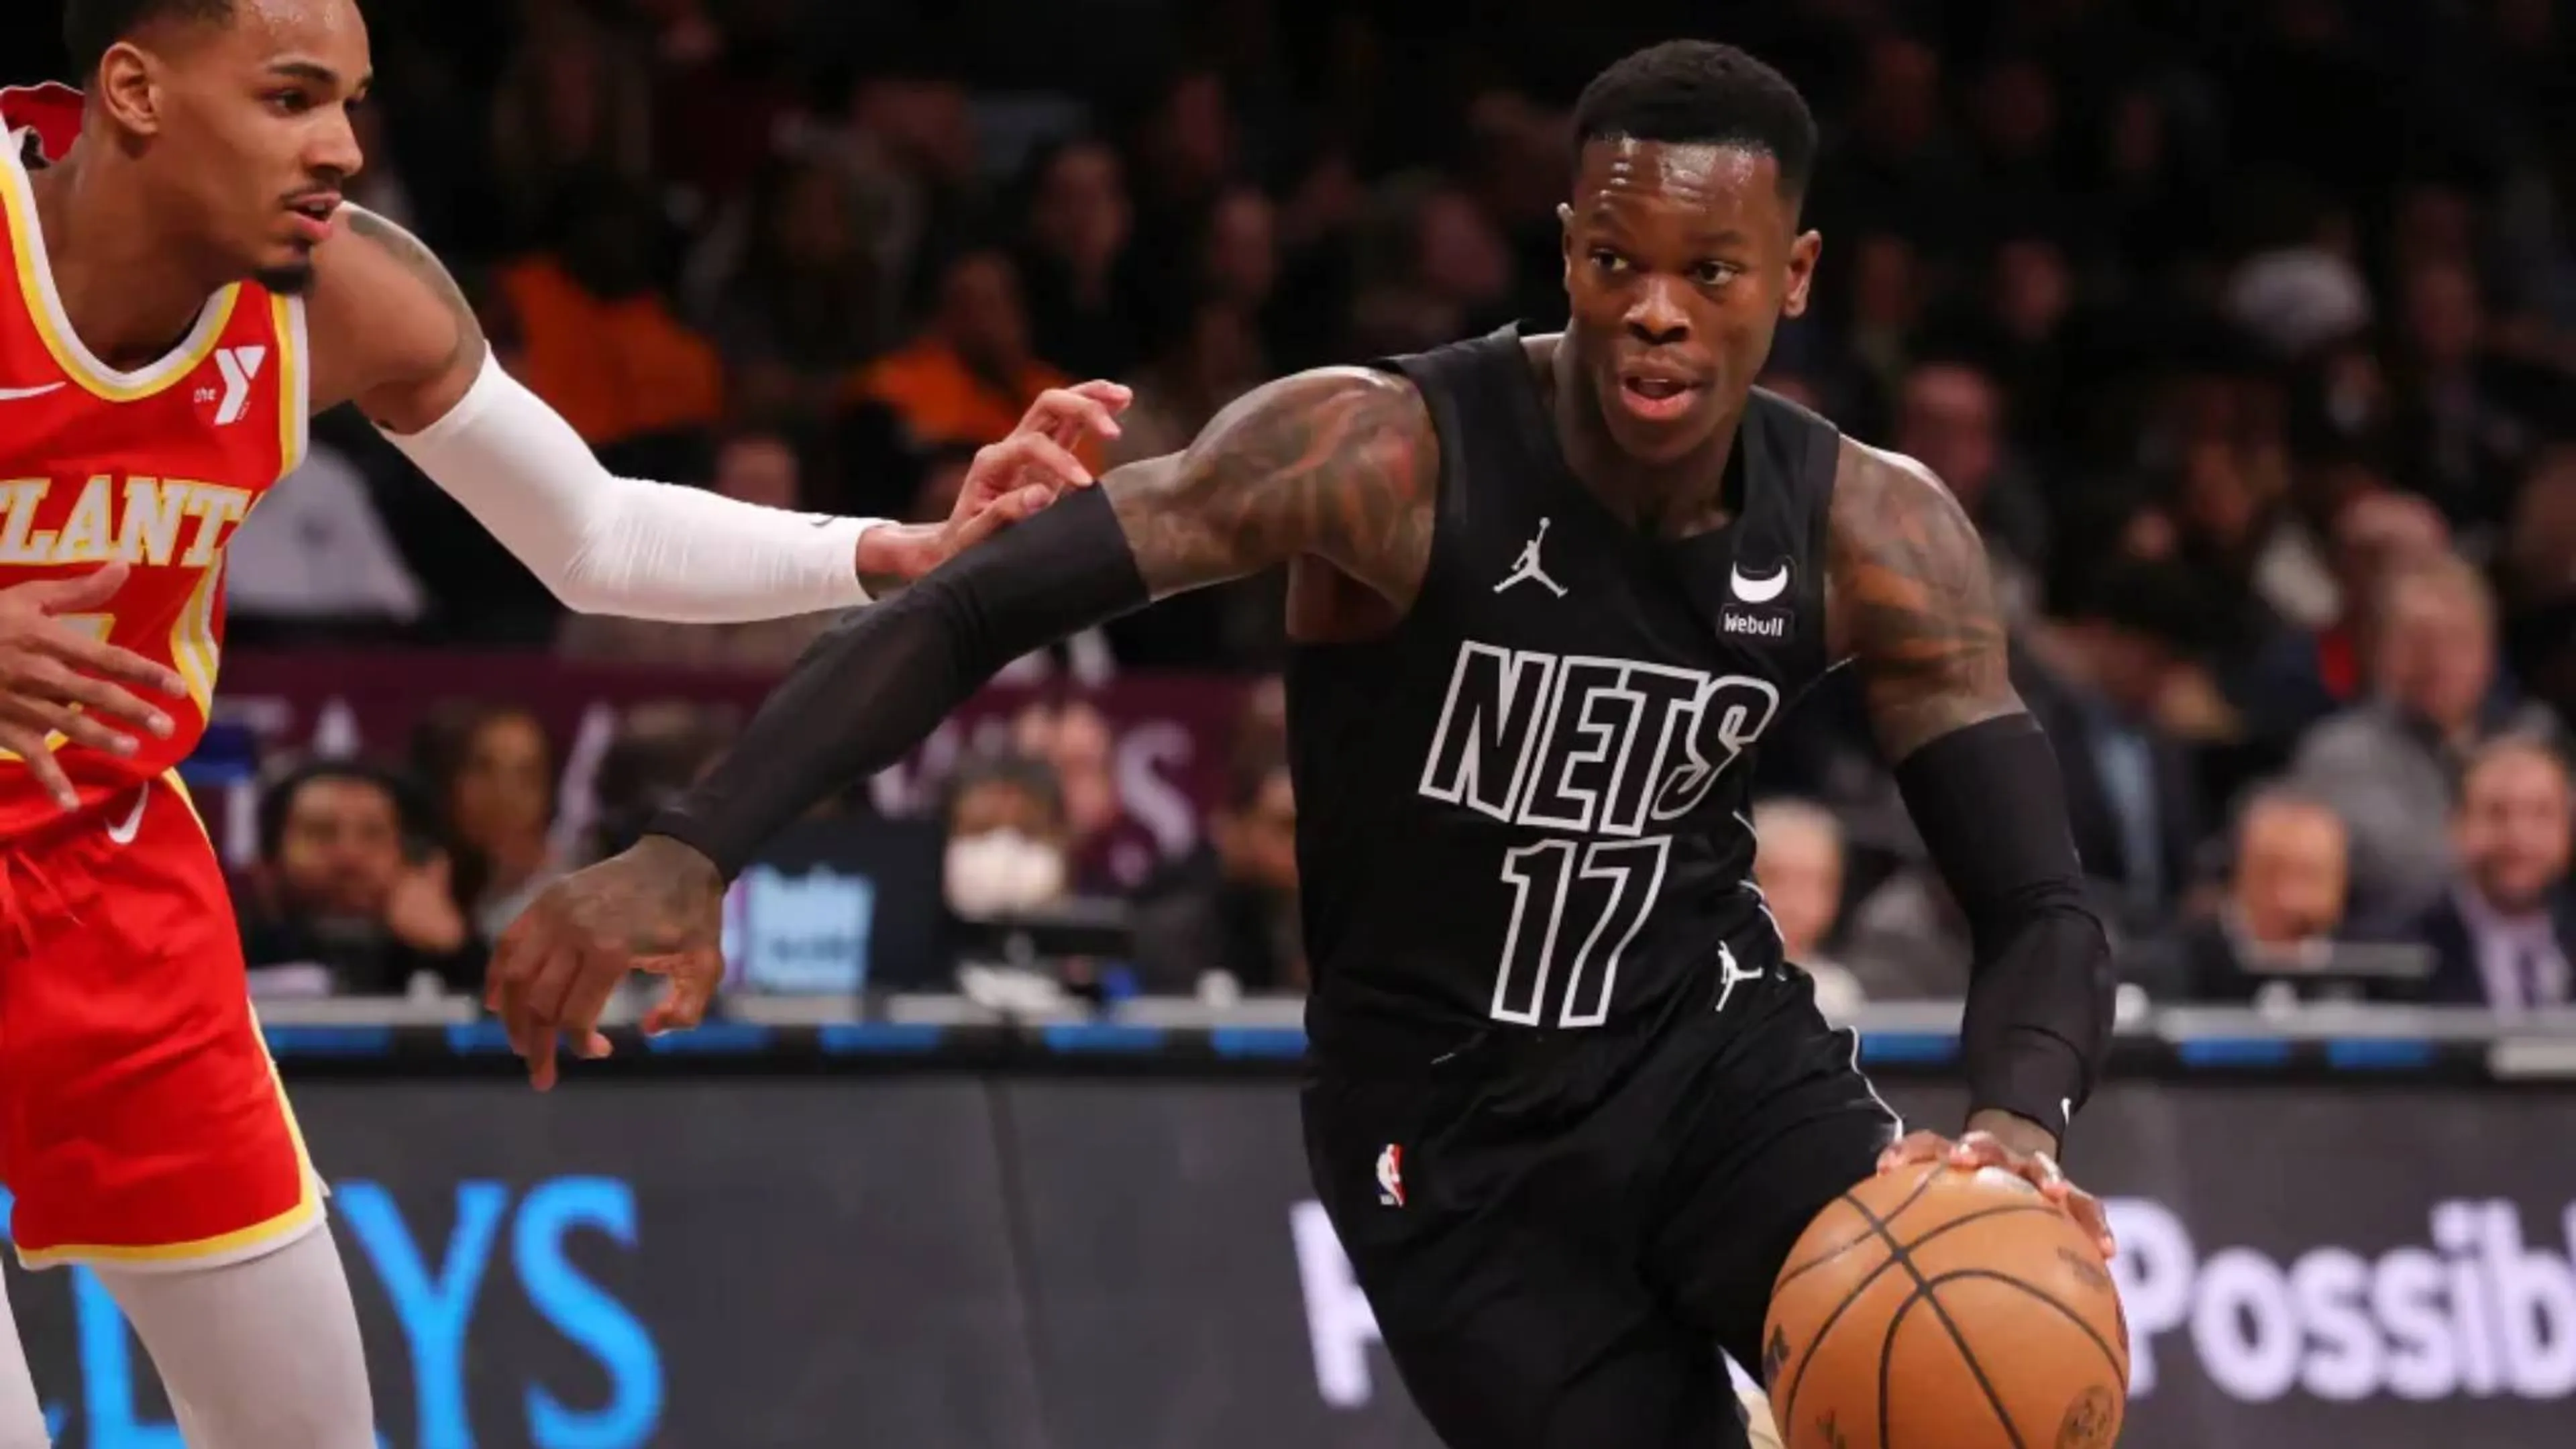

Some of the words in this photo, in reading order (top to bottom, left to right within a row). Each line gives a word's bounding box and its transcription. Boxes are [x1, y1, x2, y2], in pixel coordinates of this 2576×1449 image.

[0, 474, 253, 567] LANT
[1724, 612, 1784, 637] Webull
[1418, 640, 1780, 837] NETS
[1490, 835, 1671, 1028] 17
[2101, 1197, 2576, 1402] Possib
